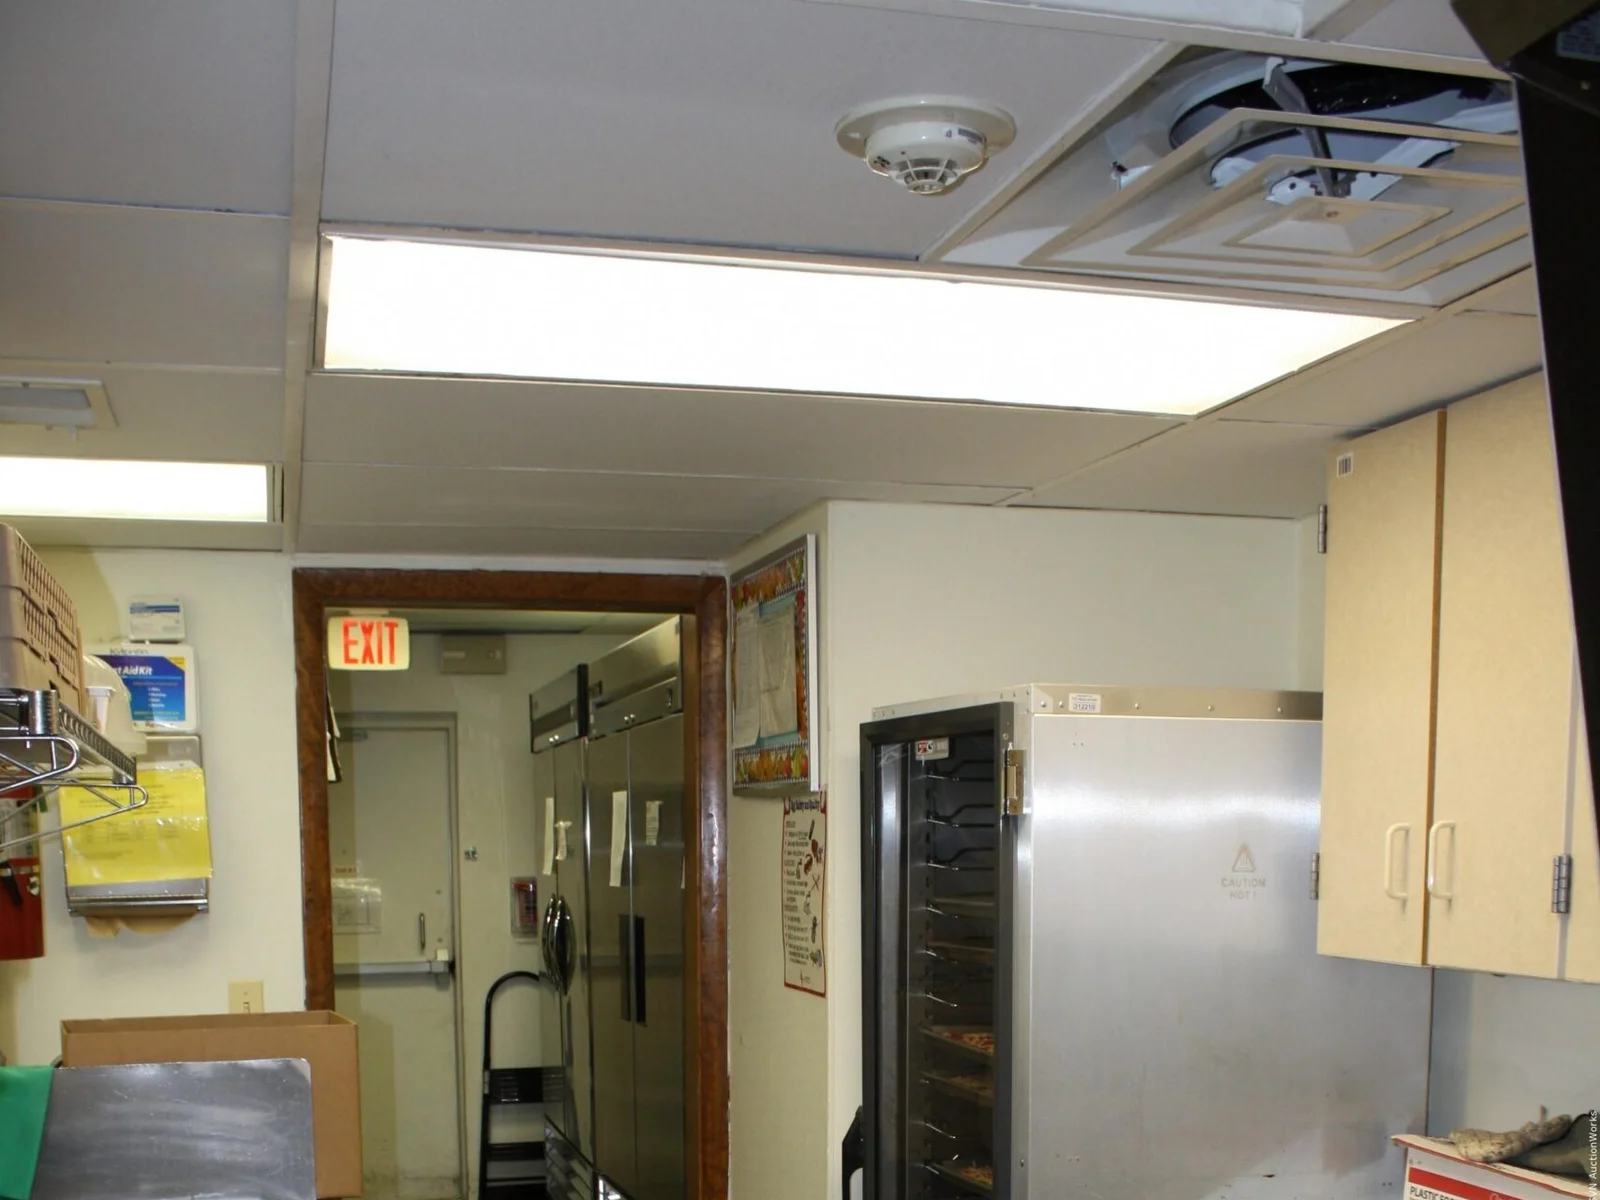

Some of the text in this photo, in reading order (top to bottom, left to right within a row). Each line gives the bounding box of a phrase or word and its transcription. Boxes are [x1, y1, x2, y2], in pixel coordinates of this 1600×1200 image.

[342, 620, 399, 664] EXIT
[122, 665, 139, 675] Aid
[140, 666, 153, 676] Kit
[1221, 878, 1266, 888] CAUTION
[1230, 890, 1250, 900] HOT
